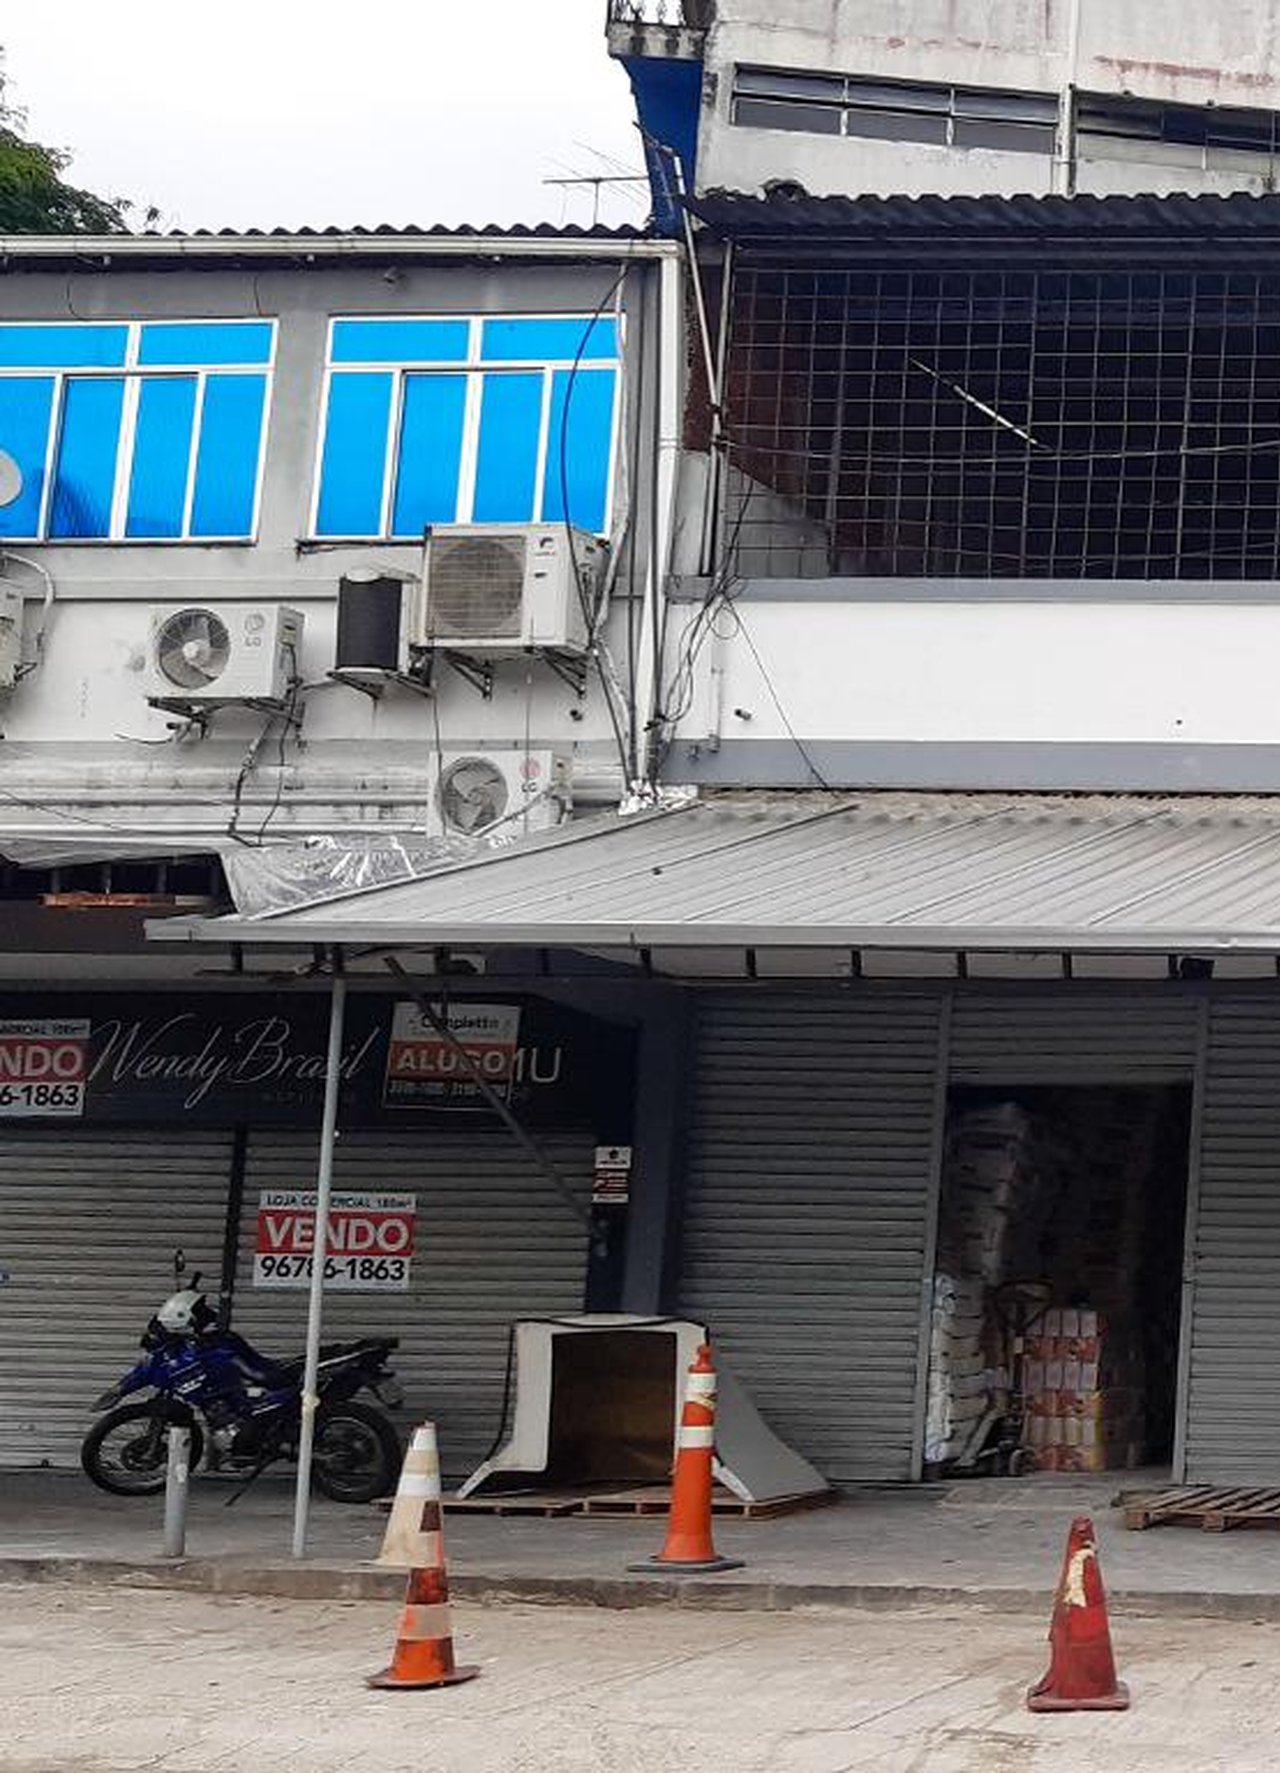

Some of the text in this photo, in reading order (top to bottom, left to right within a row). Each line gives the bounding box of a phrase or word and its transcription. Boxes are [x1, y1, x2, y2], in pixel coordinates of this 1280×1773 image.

[0, 1044, 83, 1077] NDO
[88, 1013, 380, 1109] Wendy Brail
[0, 1084, 79, 1106] 6-1863
[302, 1196, 371, 1208] COERCIAL
[265, 1216, 410, 1252] VENDO
